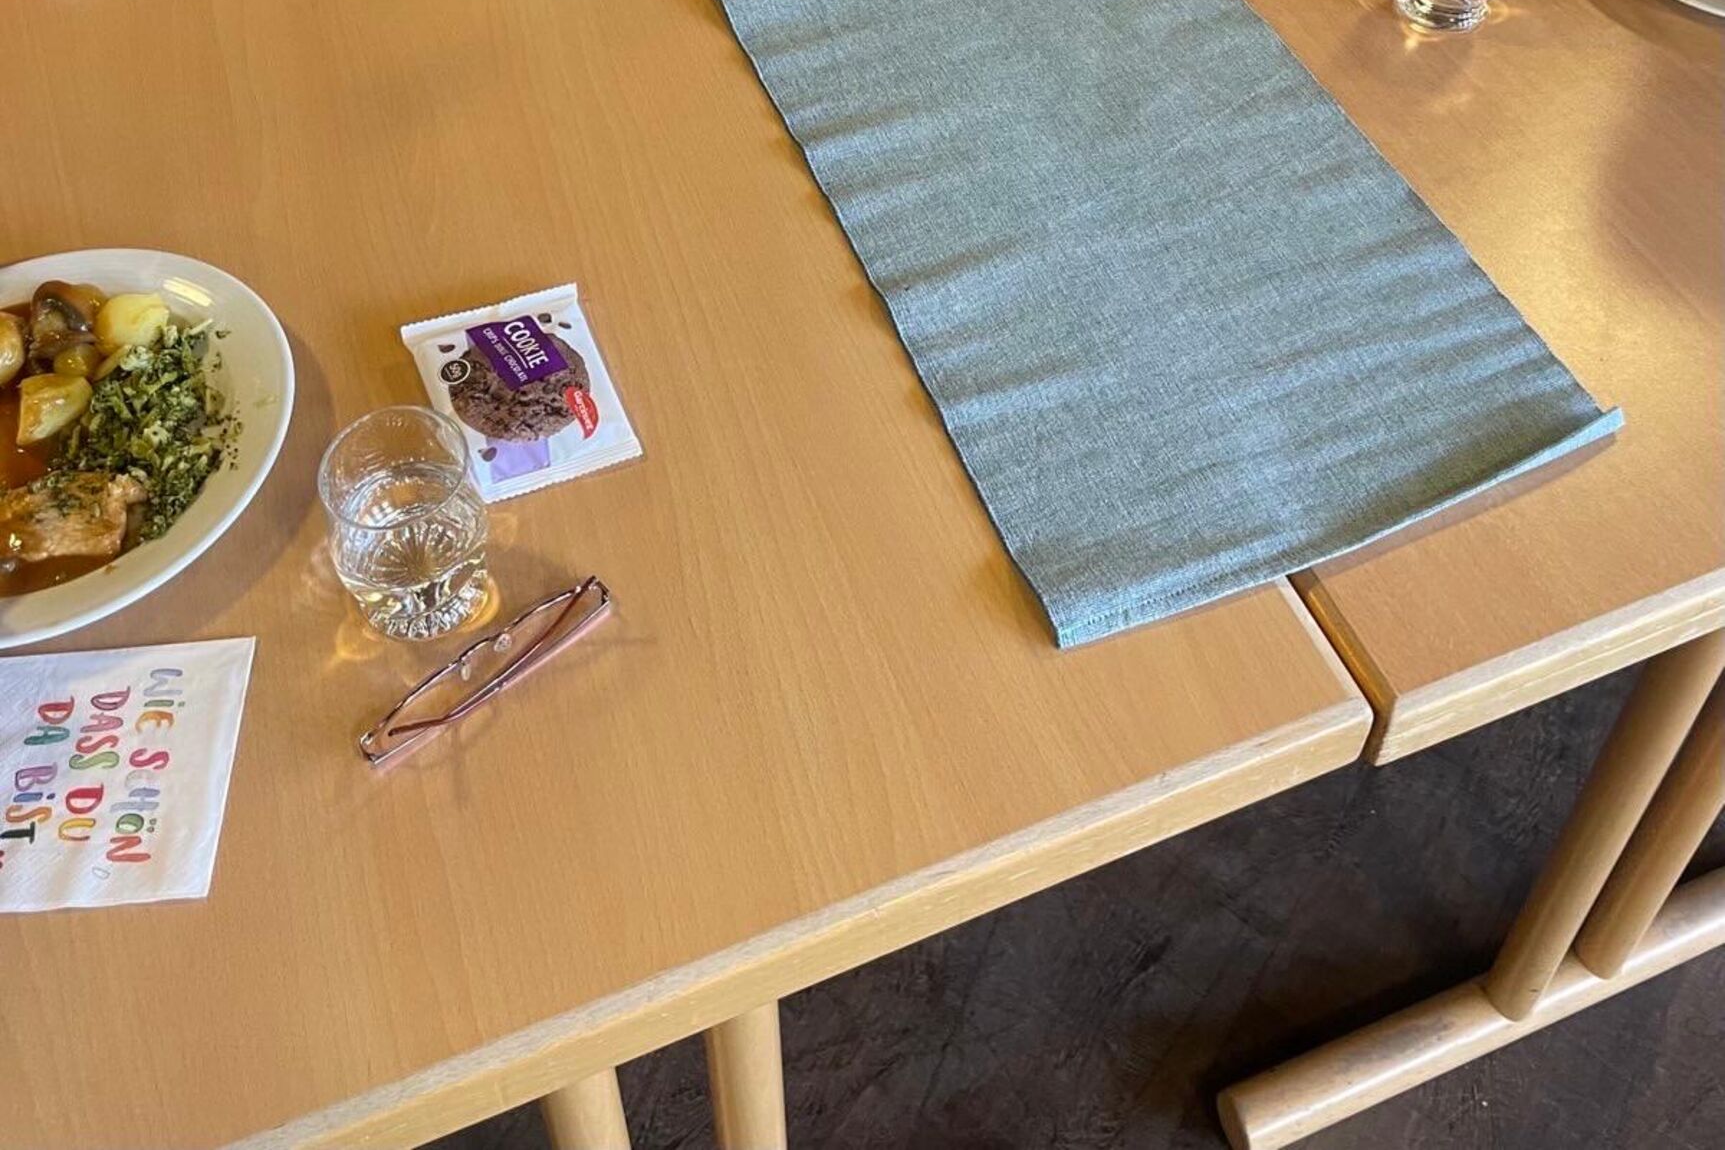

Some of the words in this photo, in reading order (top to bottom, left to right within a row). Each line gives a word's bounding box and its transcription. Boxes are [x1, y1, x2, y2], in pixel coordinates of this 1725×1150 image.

[503, 321, 549, 369] COOKIE
[23, 695, 76, 746] DA
[68, 685, 132, 771] DASS
[57, 783, 105, 842] DU
